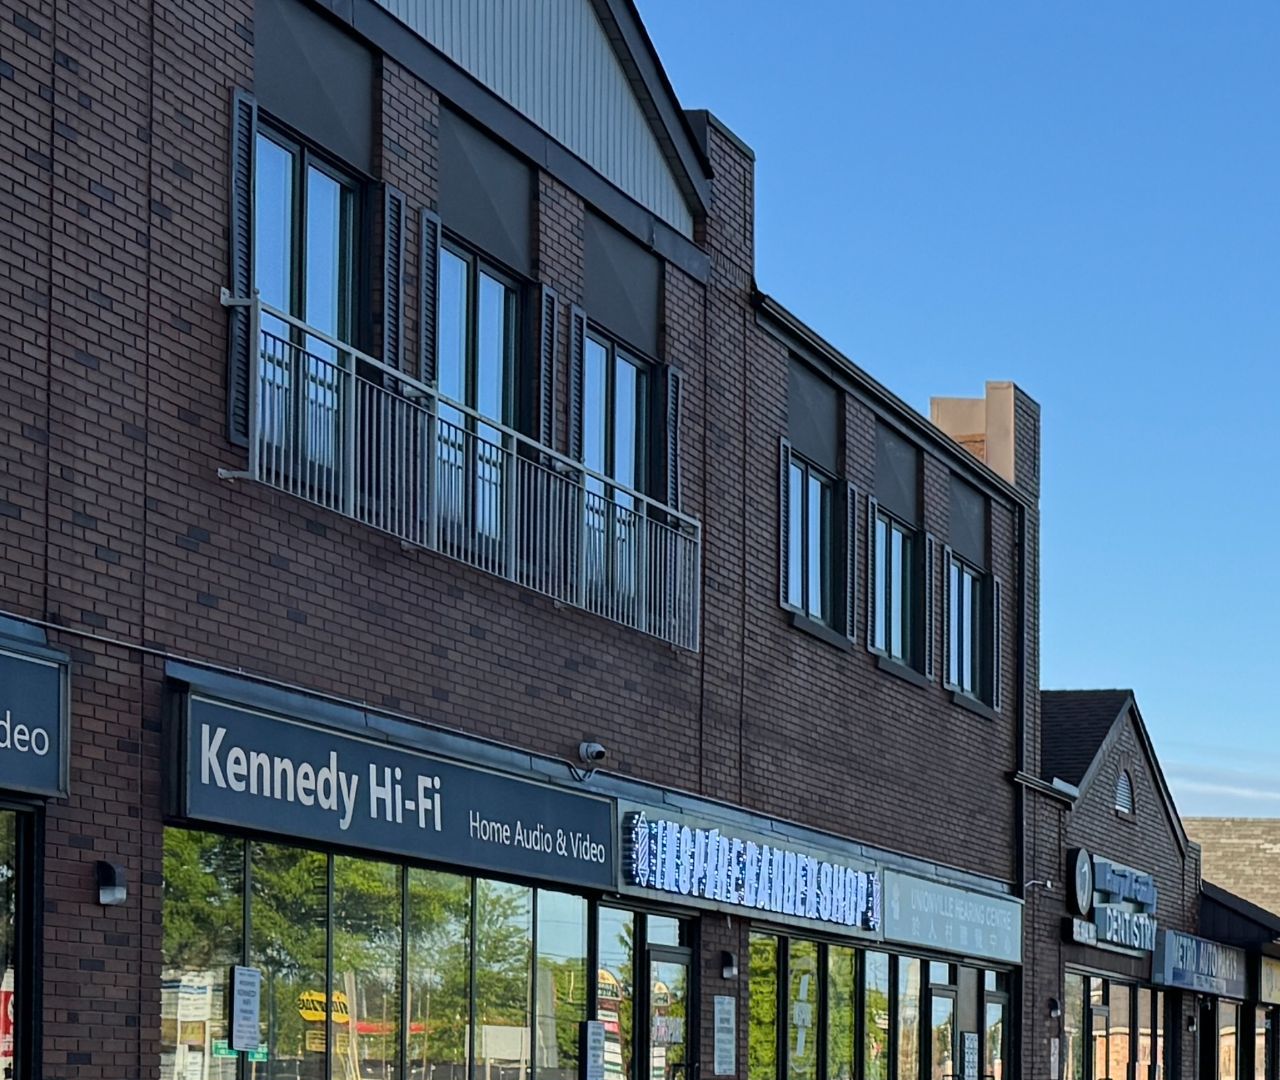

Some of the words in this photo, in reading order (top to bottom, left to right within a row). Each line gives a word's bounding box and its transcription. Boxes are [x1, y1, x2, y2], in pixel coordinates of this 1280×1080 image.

[201, 723, 359, 831] Kennedy
[369, 763, 442, 832] Hi-Fi
[469, 809, 511, 845] Home
[514, 820, 553, 853] Audio
[556, 828, 568, 857] &
[569, 831, 606, 864] Video
[743, 840, 820, 920] BARBER
[819, 861, 868, 927] SHOP
[1106, 905, 1158, 951] DENTISTRY
